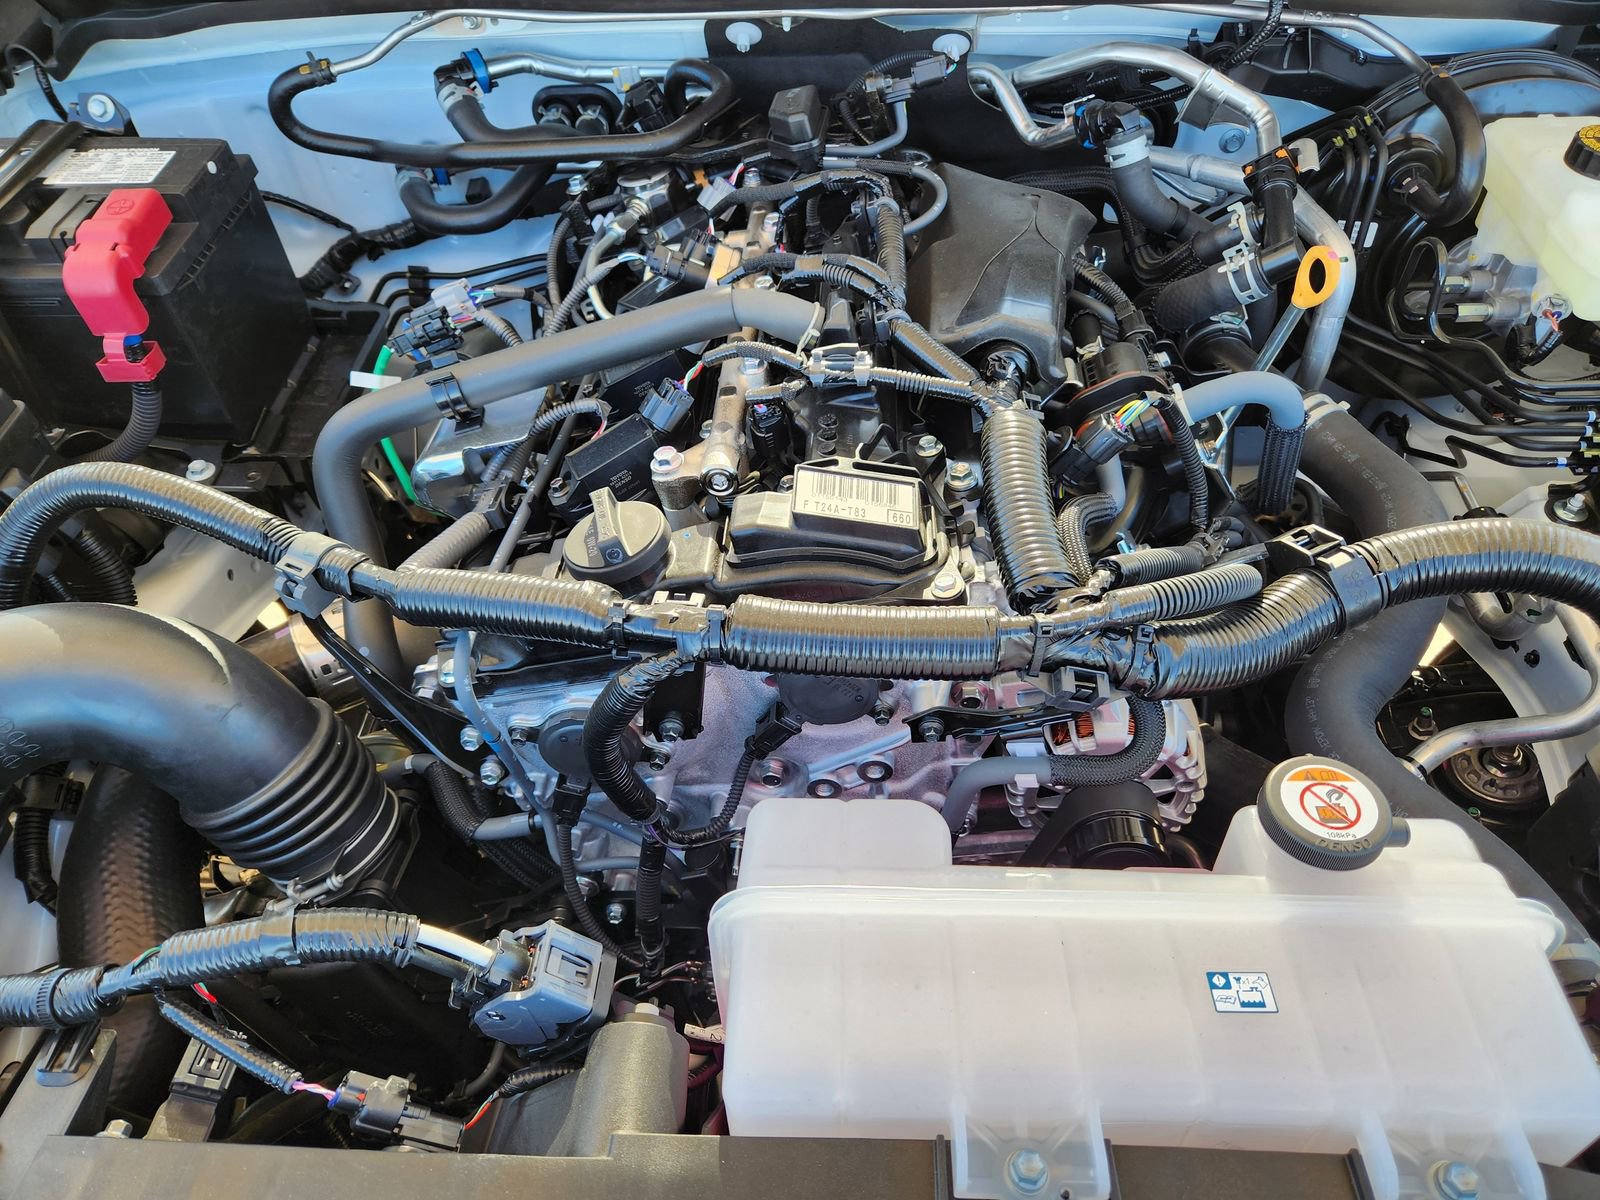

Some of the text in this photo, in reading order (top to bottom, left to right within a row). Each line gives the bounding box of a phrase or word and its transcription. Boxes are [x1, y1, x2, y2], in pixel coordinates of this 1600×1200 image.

[814, 501, 866, 518] T24A-T83
[892, 512, 911, 525] 660
[1318, 838, 1372, 852] DENSO
